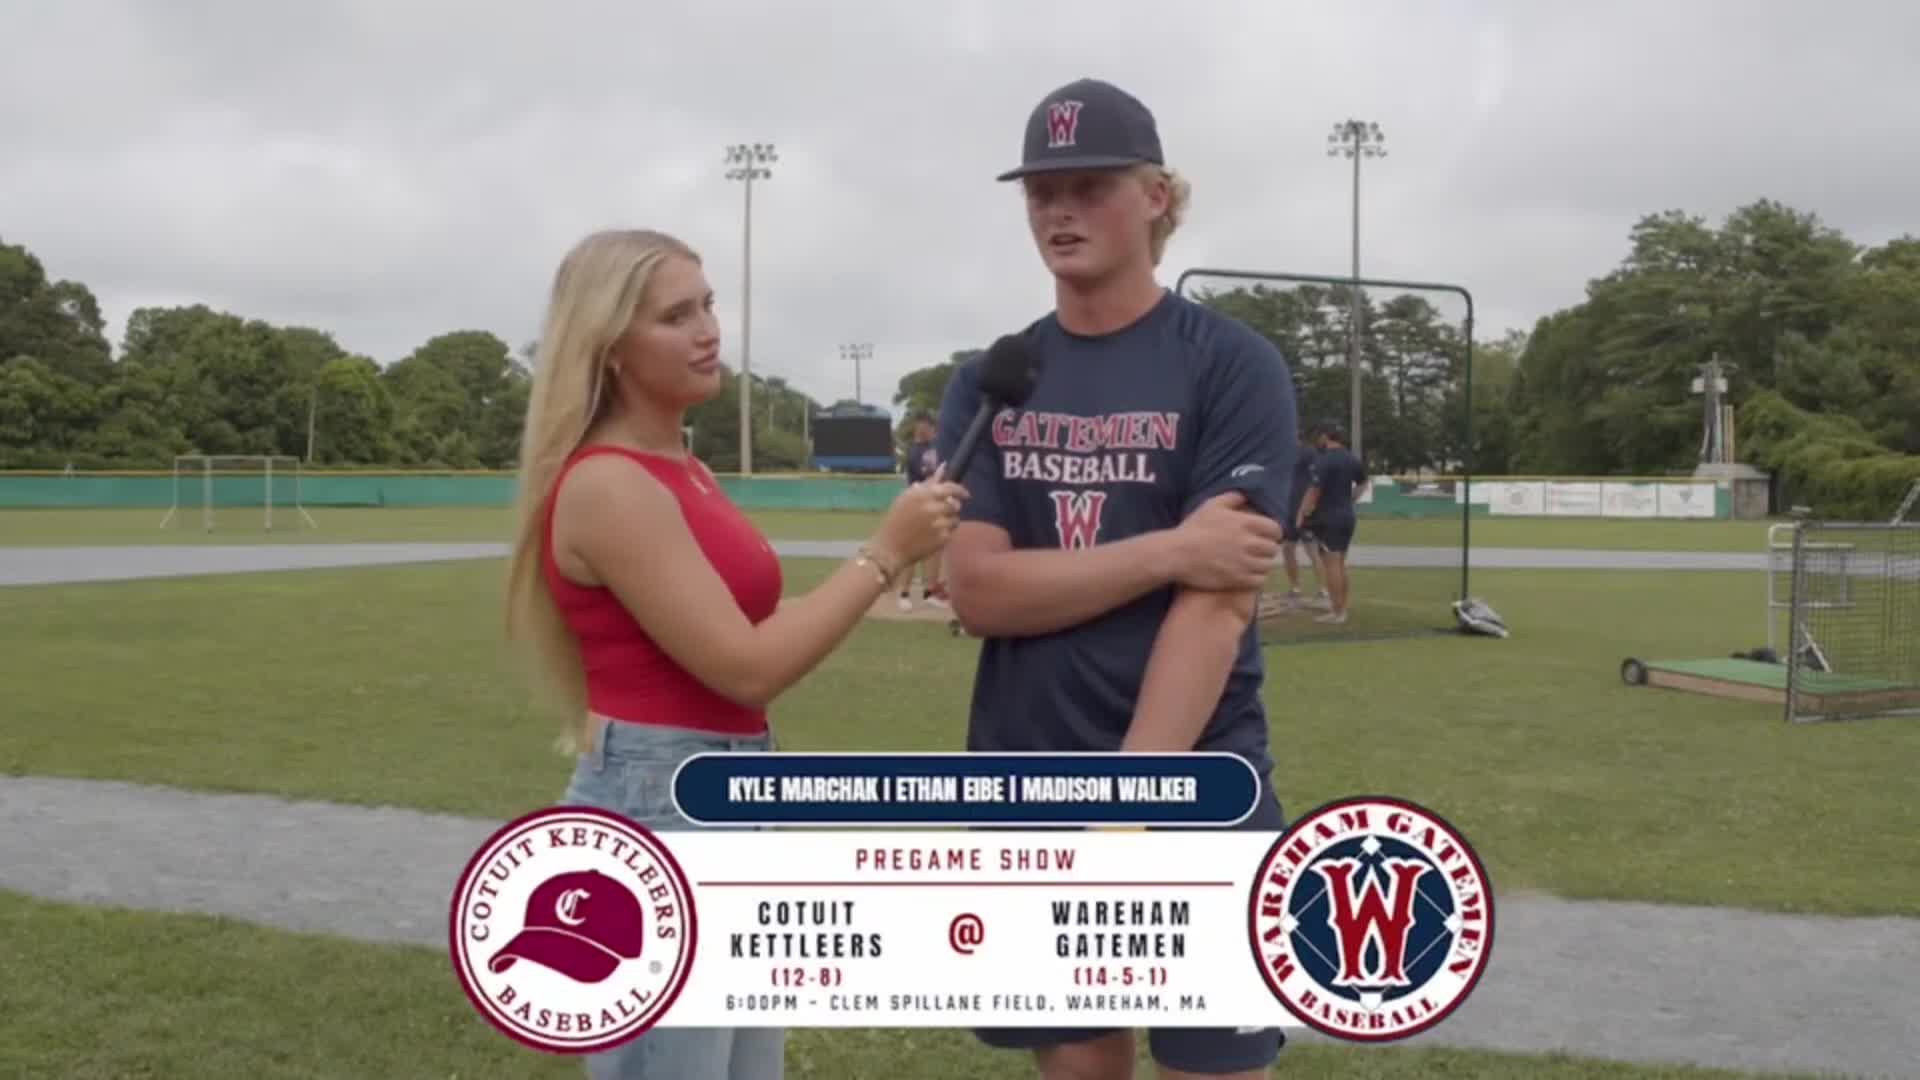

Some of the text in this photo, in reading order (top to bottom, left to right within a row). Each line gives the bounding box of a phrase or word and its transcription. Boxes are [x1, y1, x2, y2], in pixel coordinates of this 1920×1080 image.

[1047, 100, 1083, 148] W
[992, 410, 1180, 450] GATEMEN
[1003, 451, 1155, 483] BASEBALL
[1049, 490, 1106, 550] W
